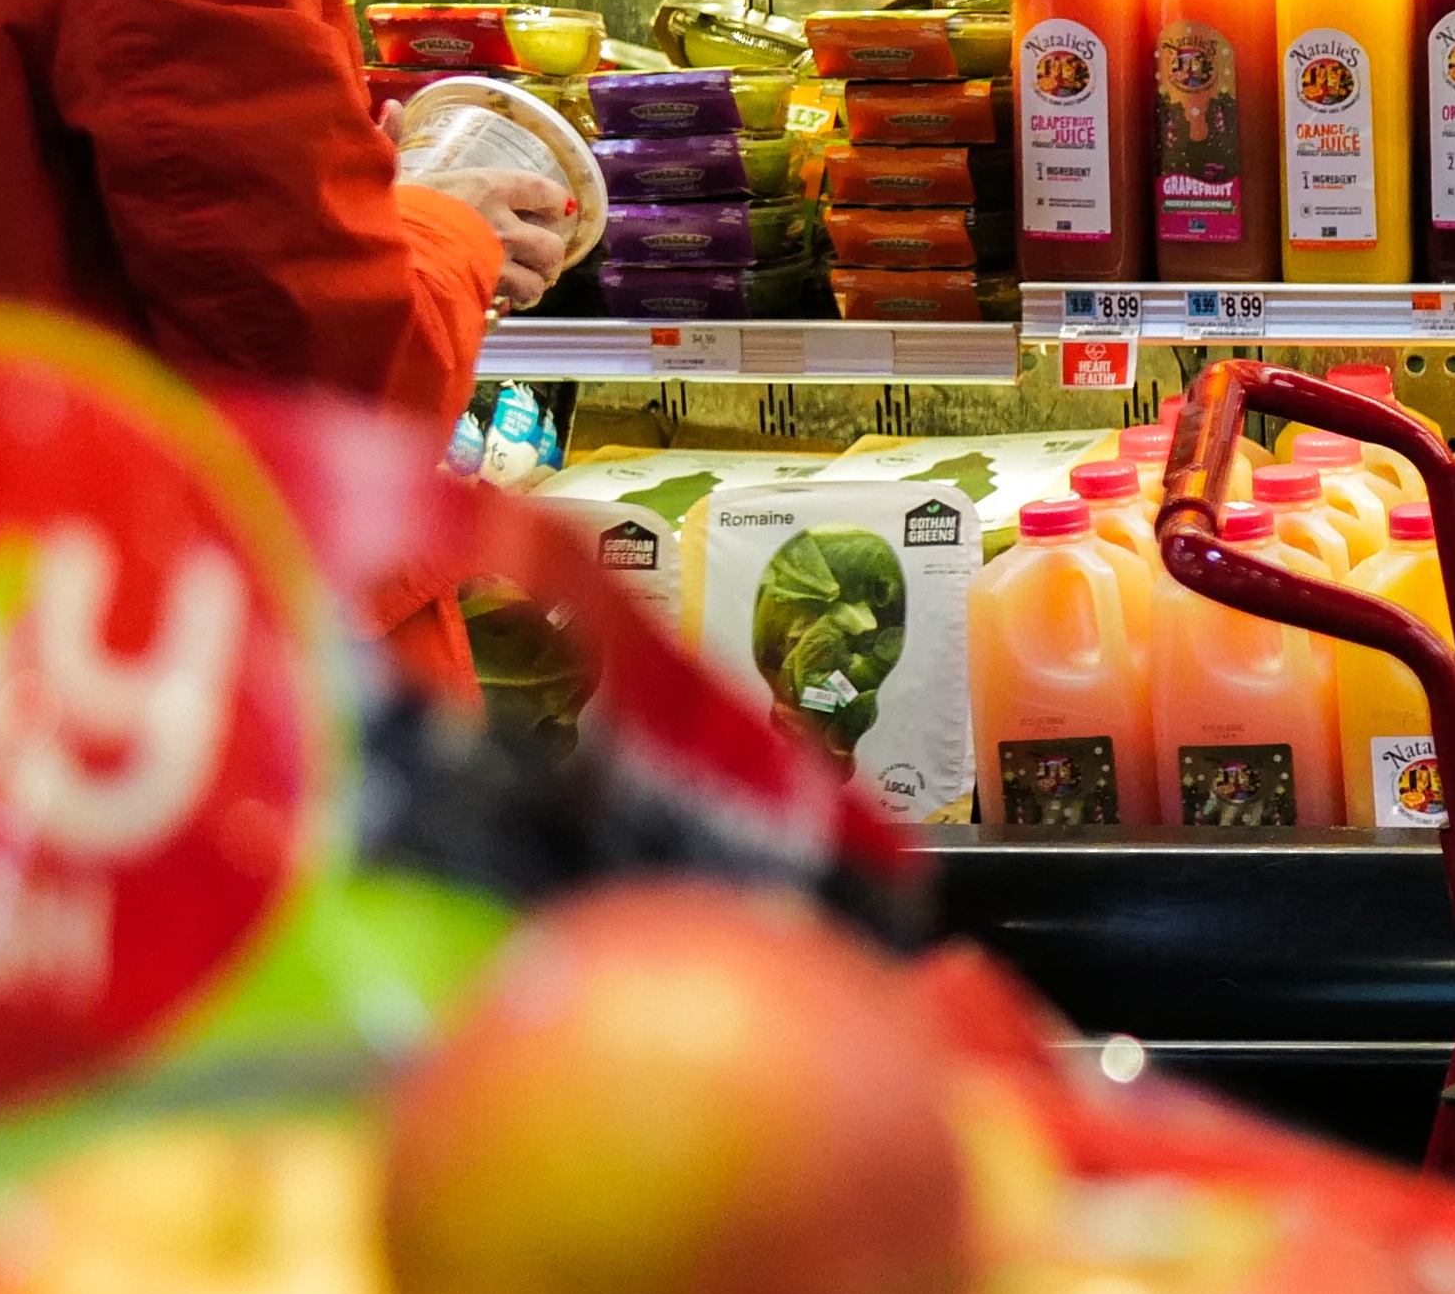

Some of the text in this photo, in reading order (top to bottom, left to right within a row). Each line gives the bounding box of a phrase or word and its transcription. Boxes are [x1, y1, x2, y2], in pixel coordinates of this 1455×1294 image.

[1031, 115, 1095, 133] GRAPEFRUIT
[1297, 123, 1345, 140] ORANGE
[1054, 127, 1096, 145] JUICE
[1317, 134, 1361, 153] JUICE
[1162, 177, 1235, 199] GRAPEFRUIT
[1078, 360, 1113, 372] HEART
[1073, 372, 1117, 385] HEALTHY
[720, 511, 794, 526] Romaine
[909, 515, 956, 529] GOTHAM
[909, 528, 956, 543] GREENS
[604, 539, 654, 552] GOTHAM
[602, 553, 654, 565] GREENS
[884, 781, 916, 798] LOCAL
